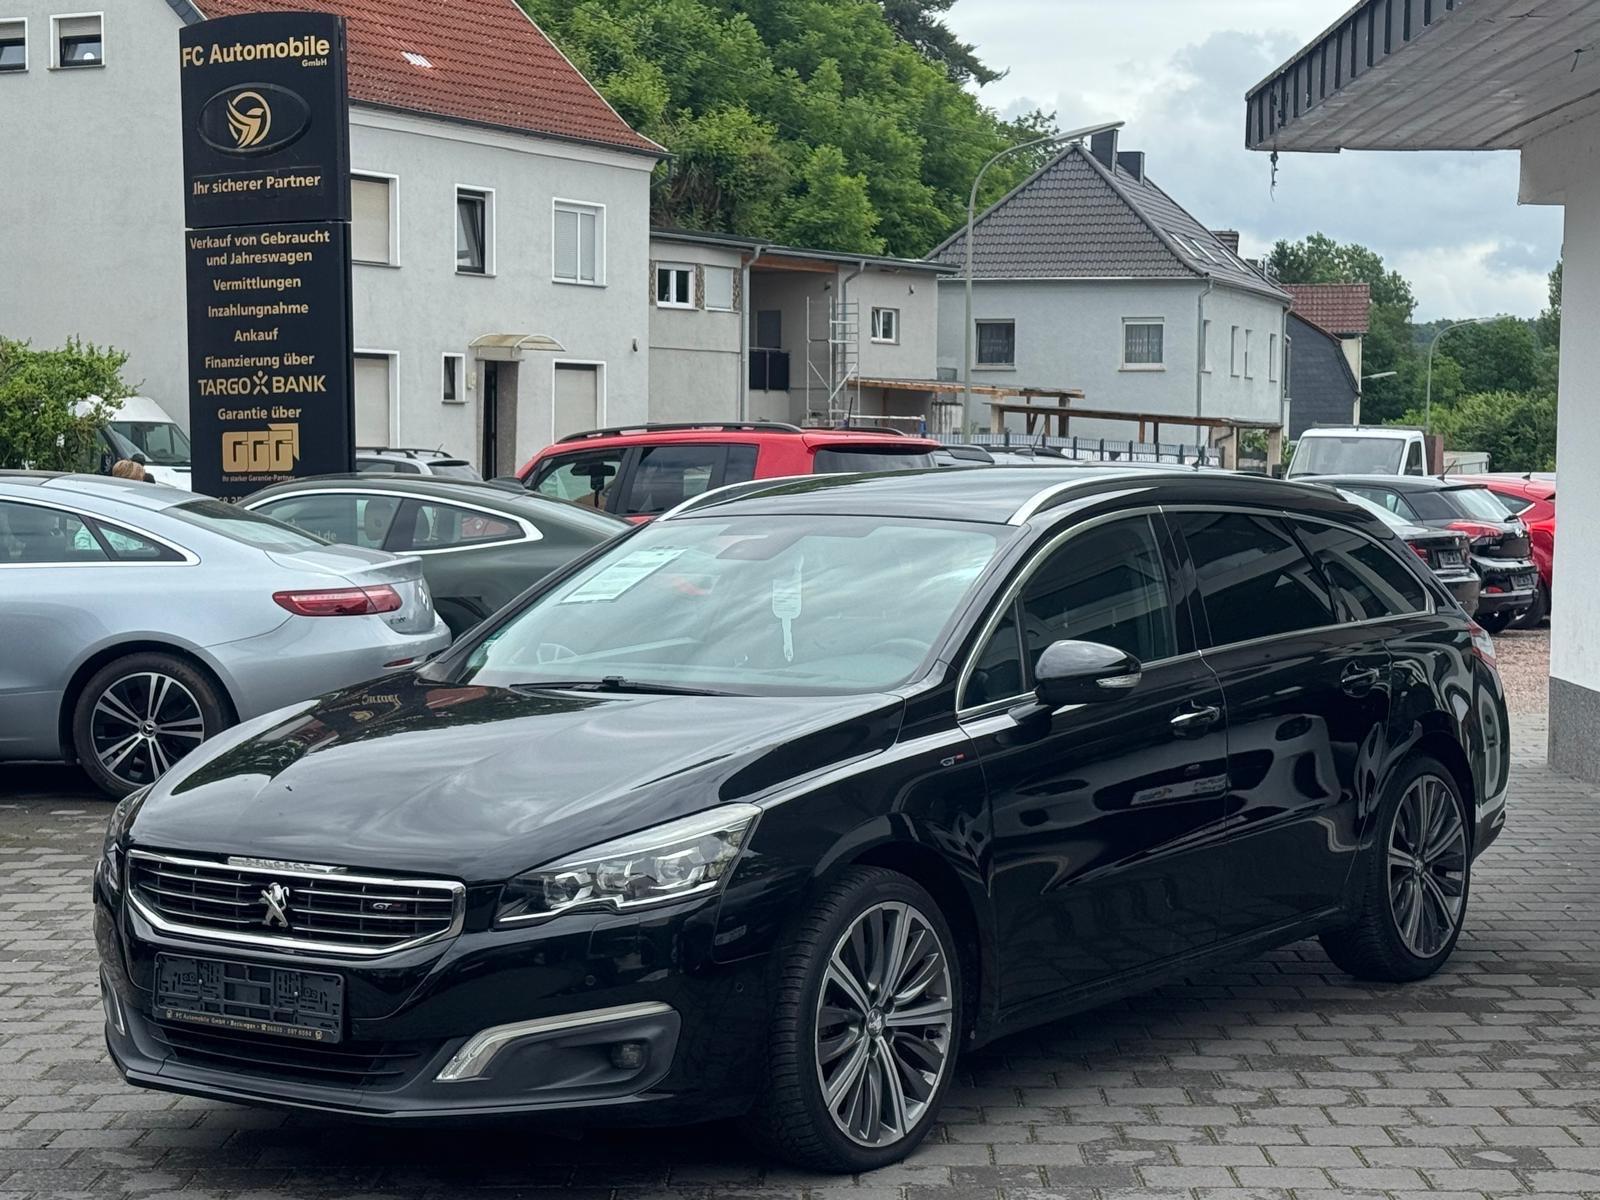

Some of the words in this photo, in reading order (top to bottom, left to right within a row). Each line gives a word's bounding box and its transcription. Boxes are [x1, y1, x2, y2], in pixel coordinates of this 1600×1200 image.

[182, 46, 204, 67] FC
[209, 36, 330, 64] Automobile
[301, 58, 327, 67] GmbH
[193, 182, 209, 195] Ihr
[212, 178, 263, 193] sicherer
[266, 175, 321, 189] Partner
[190, 234, 231, 249] Verkauf
[234, 236, 257, 246] von
[260, 230, 330, 245] Gebraucht
[206, 253, 227, 266] und
[230, 251, 313, 266] Jahreswagen
[213, 277, 301, 291] Vermittlungen
[208, 302, 309, 318] Inzahlungnahme
[234, 328, 278, 342] Ankauf
[205, 355, 280, 369] Finanzierung
[283, 353, 315, 366] über
[217, 406, 268, 420] Garantie
[271, 405, 302, 419] über
